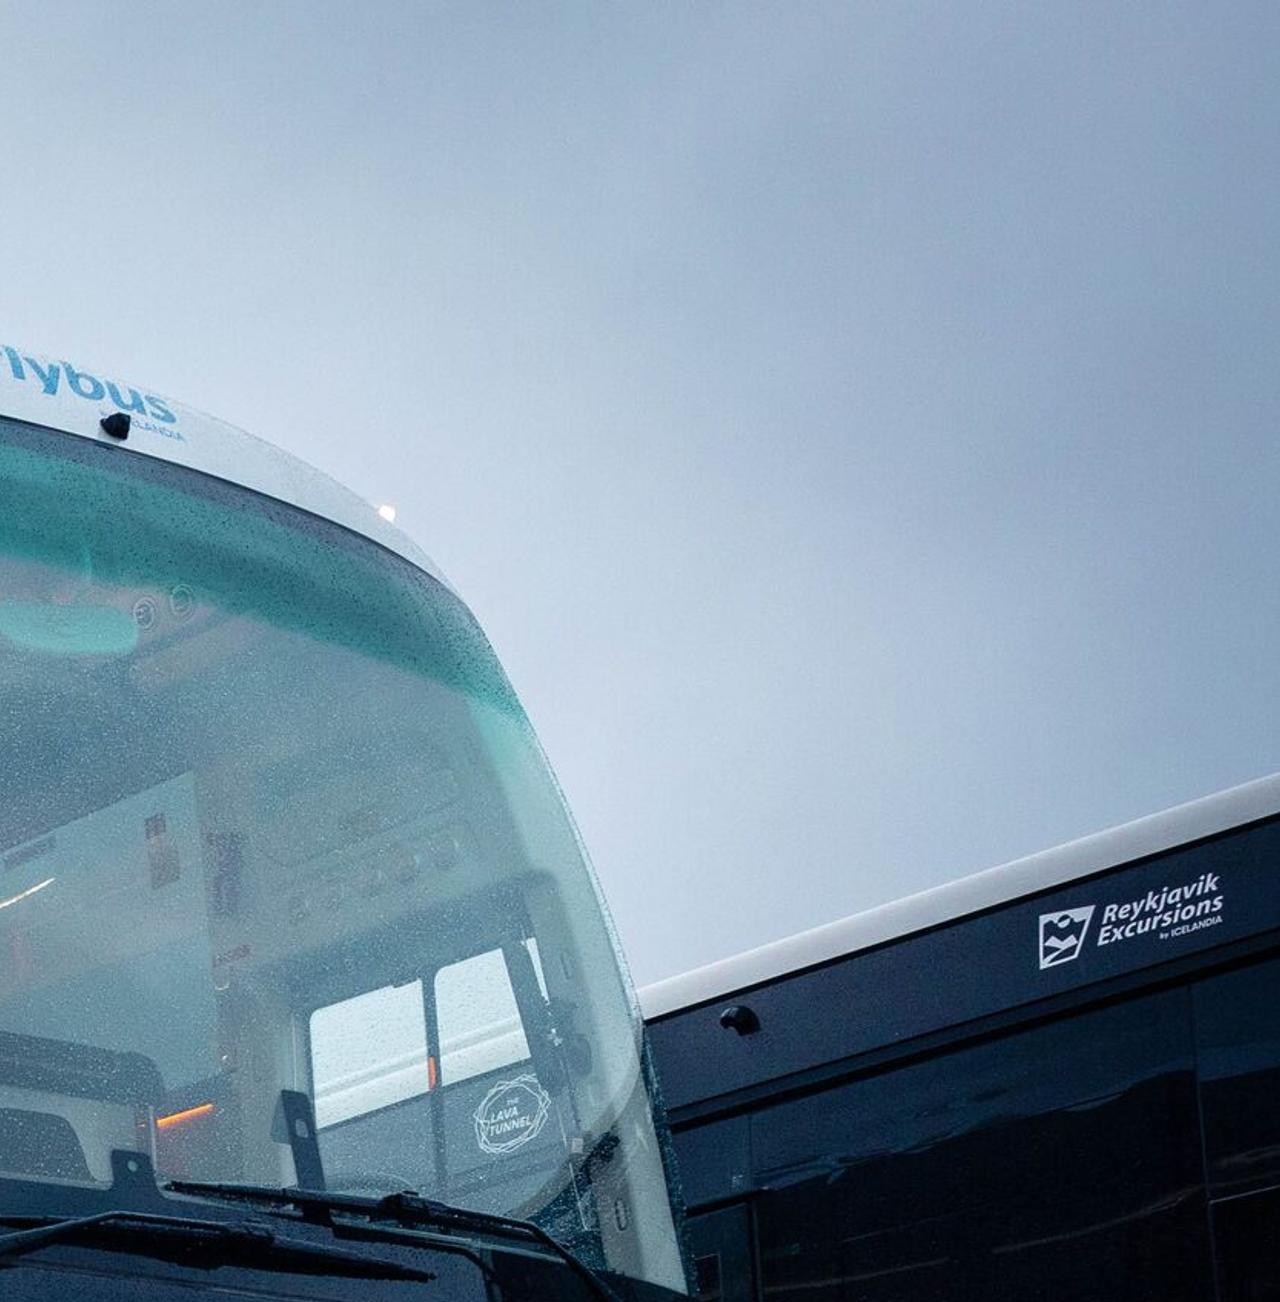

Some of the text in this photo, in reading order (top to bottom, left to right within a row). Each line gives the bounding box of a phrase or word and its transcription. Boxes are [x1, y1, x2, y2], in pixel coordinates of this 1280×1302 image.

[1101, 872, 1220, 926] Reykjavik
[1097, 895, 1224, 946] Excursions
[1159, 915, 1223, 940] by ICELANDIA
[489, 1114, 533, 1137] TUNNEL
[490, 1105, 518, 1124] LAVA
